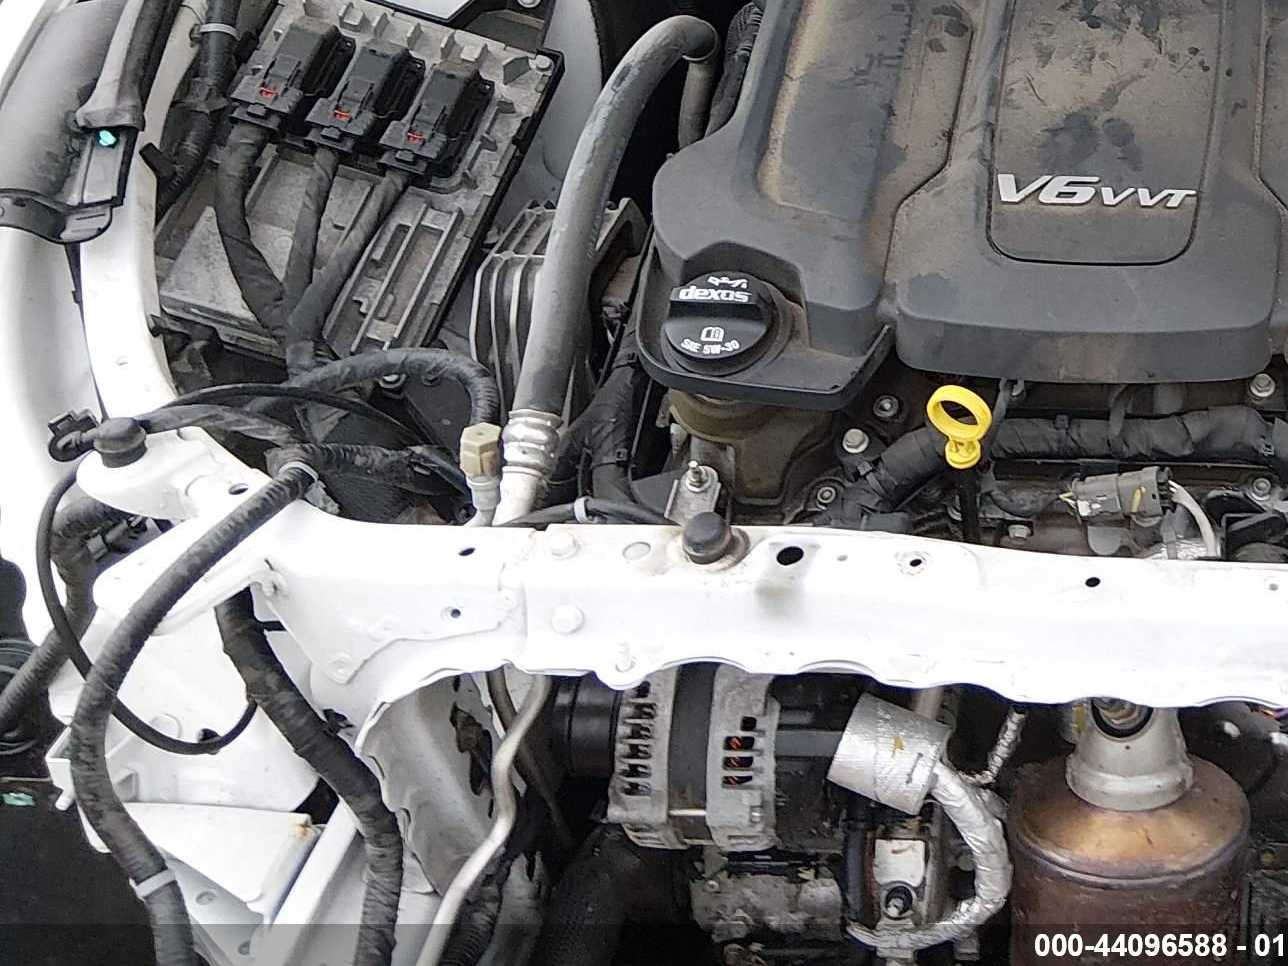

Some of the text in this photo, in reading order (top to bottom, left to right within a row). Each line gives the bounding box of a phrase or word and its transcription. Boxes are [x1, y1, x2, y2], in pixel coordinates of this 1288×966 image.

[997, 173, 1197, 208] V6 VVT
[679, 286, 752, 303] dexos
[681, 339, 740, 355] SAE 5W-30
